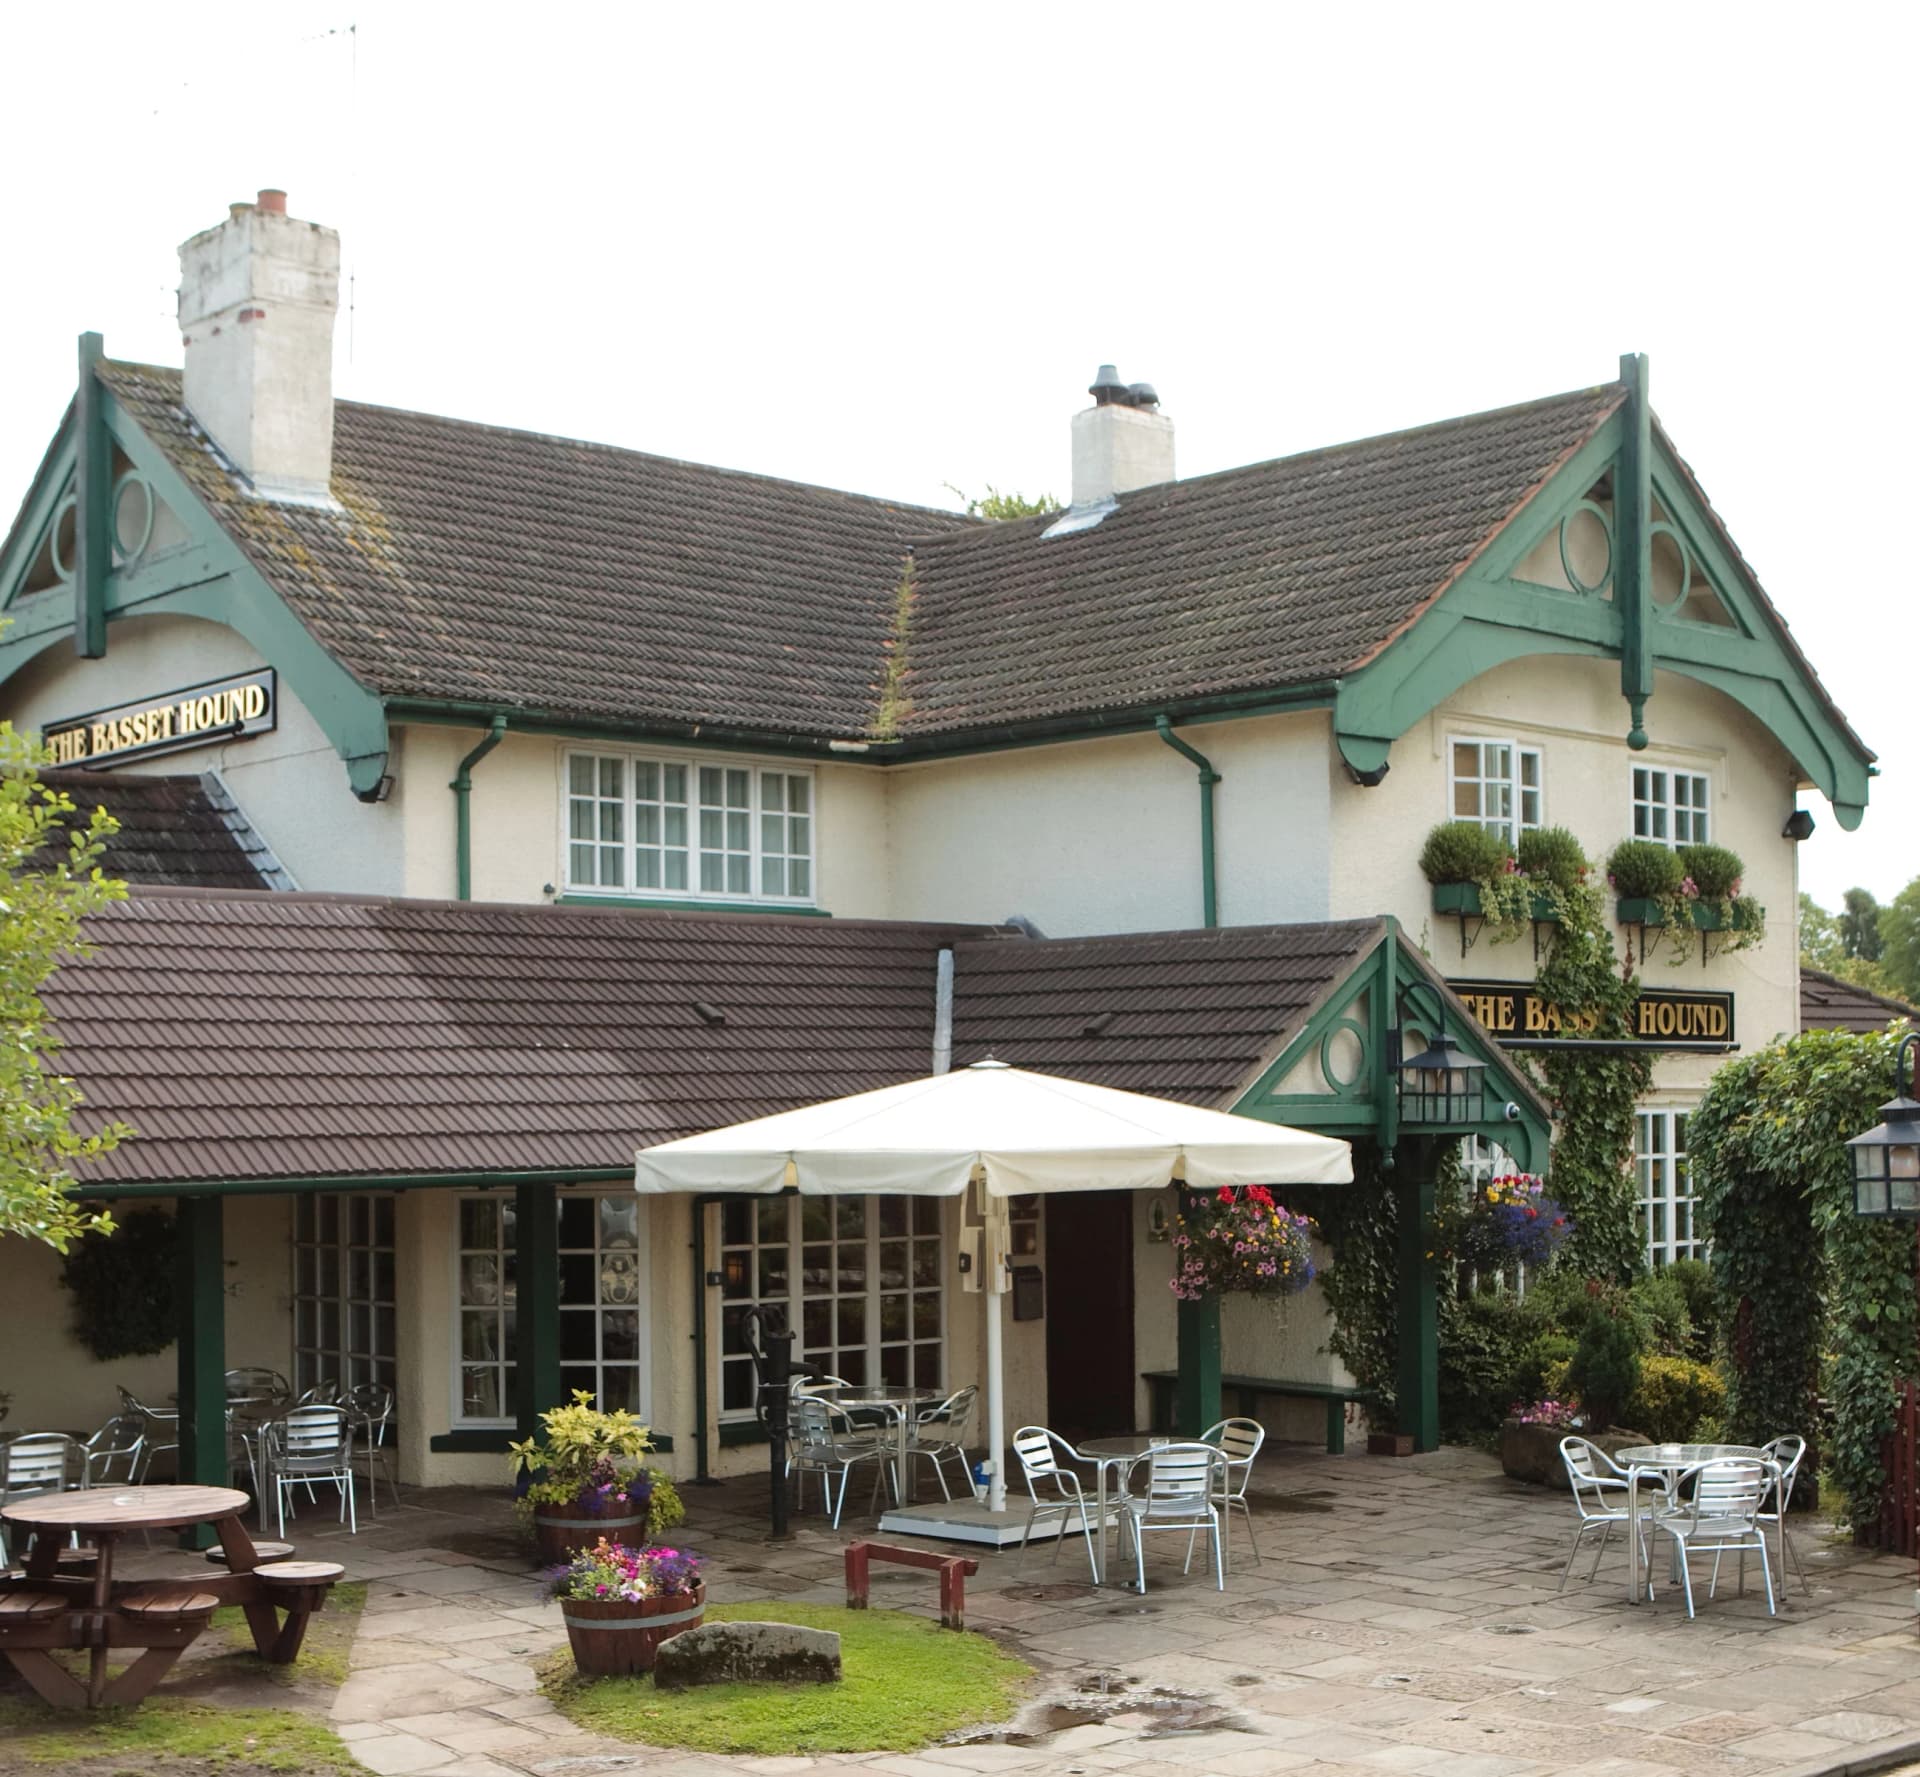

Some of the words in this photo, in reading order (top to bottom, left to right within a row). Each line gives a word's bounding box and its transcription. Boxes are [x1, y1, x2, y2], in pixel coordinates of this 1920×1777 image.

[47, 729, 87, 765] THE
[92, 711, 176, 754] BASSET
[179, 684, 264, 732] HOUND
[1525, 997, 1608, 1033] BASS
[1639, 1001, 1728, 1037] HOUND
